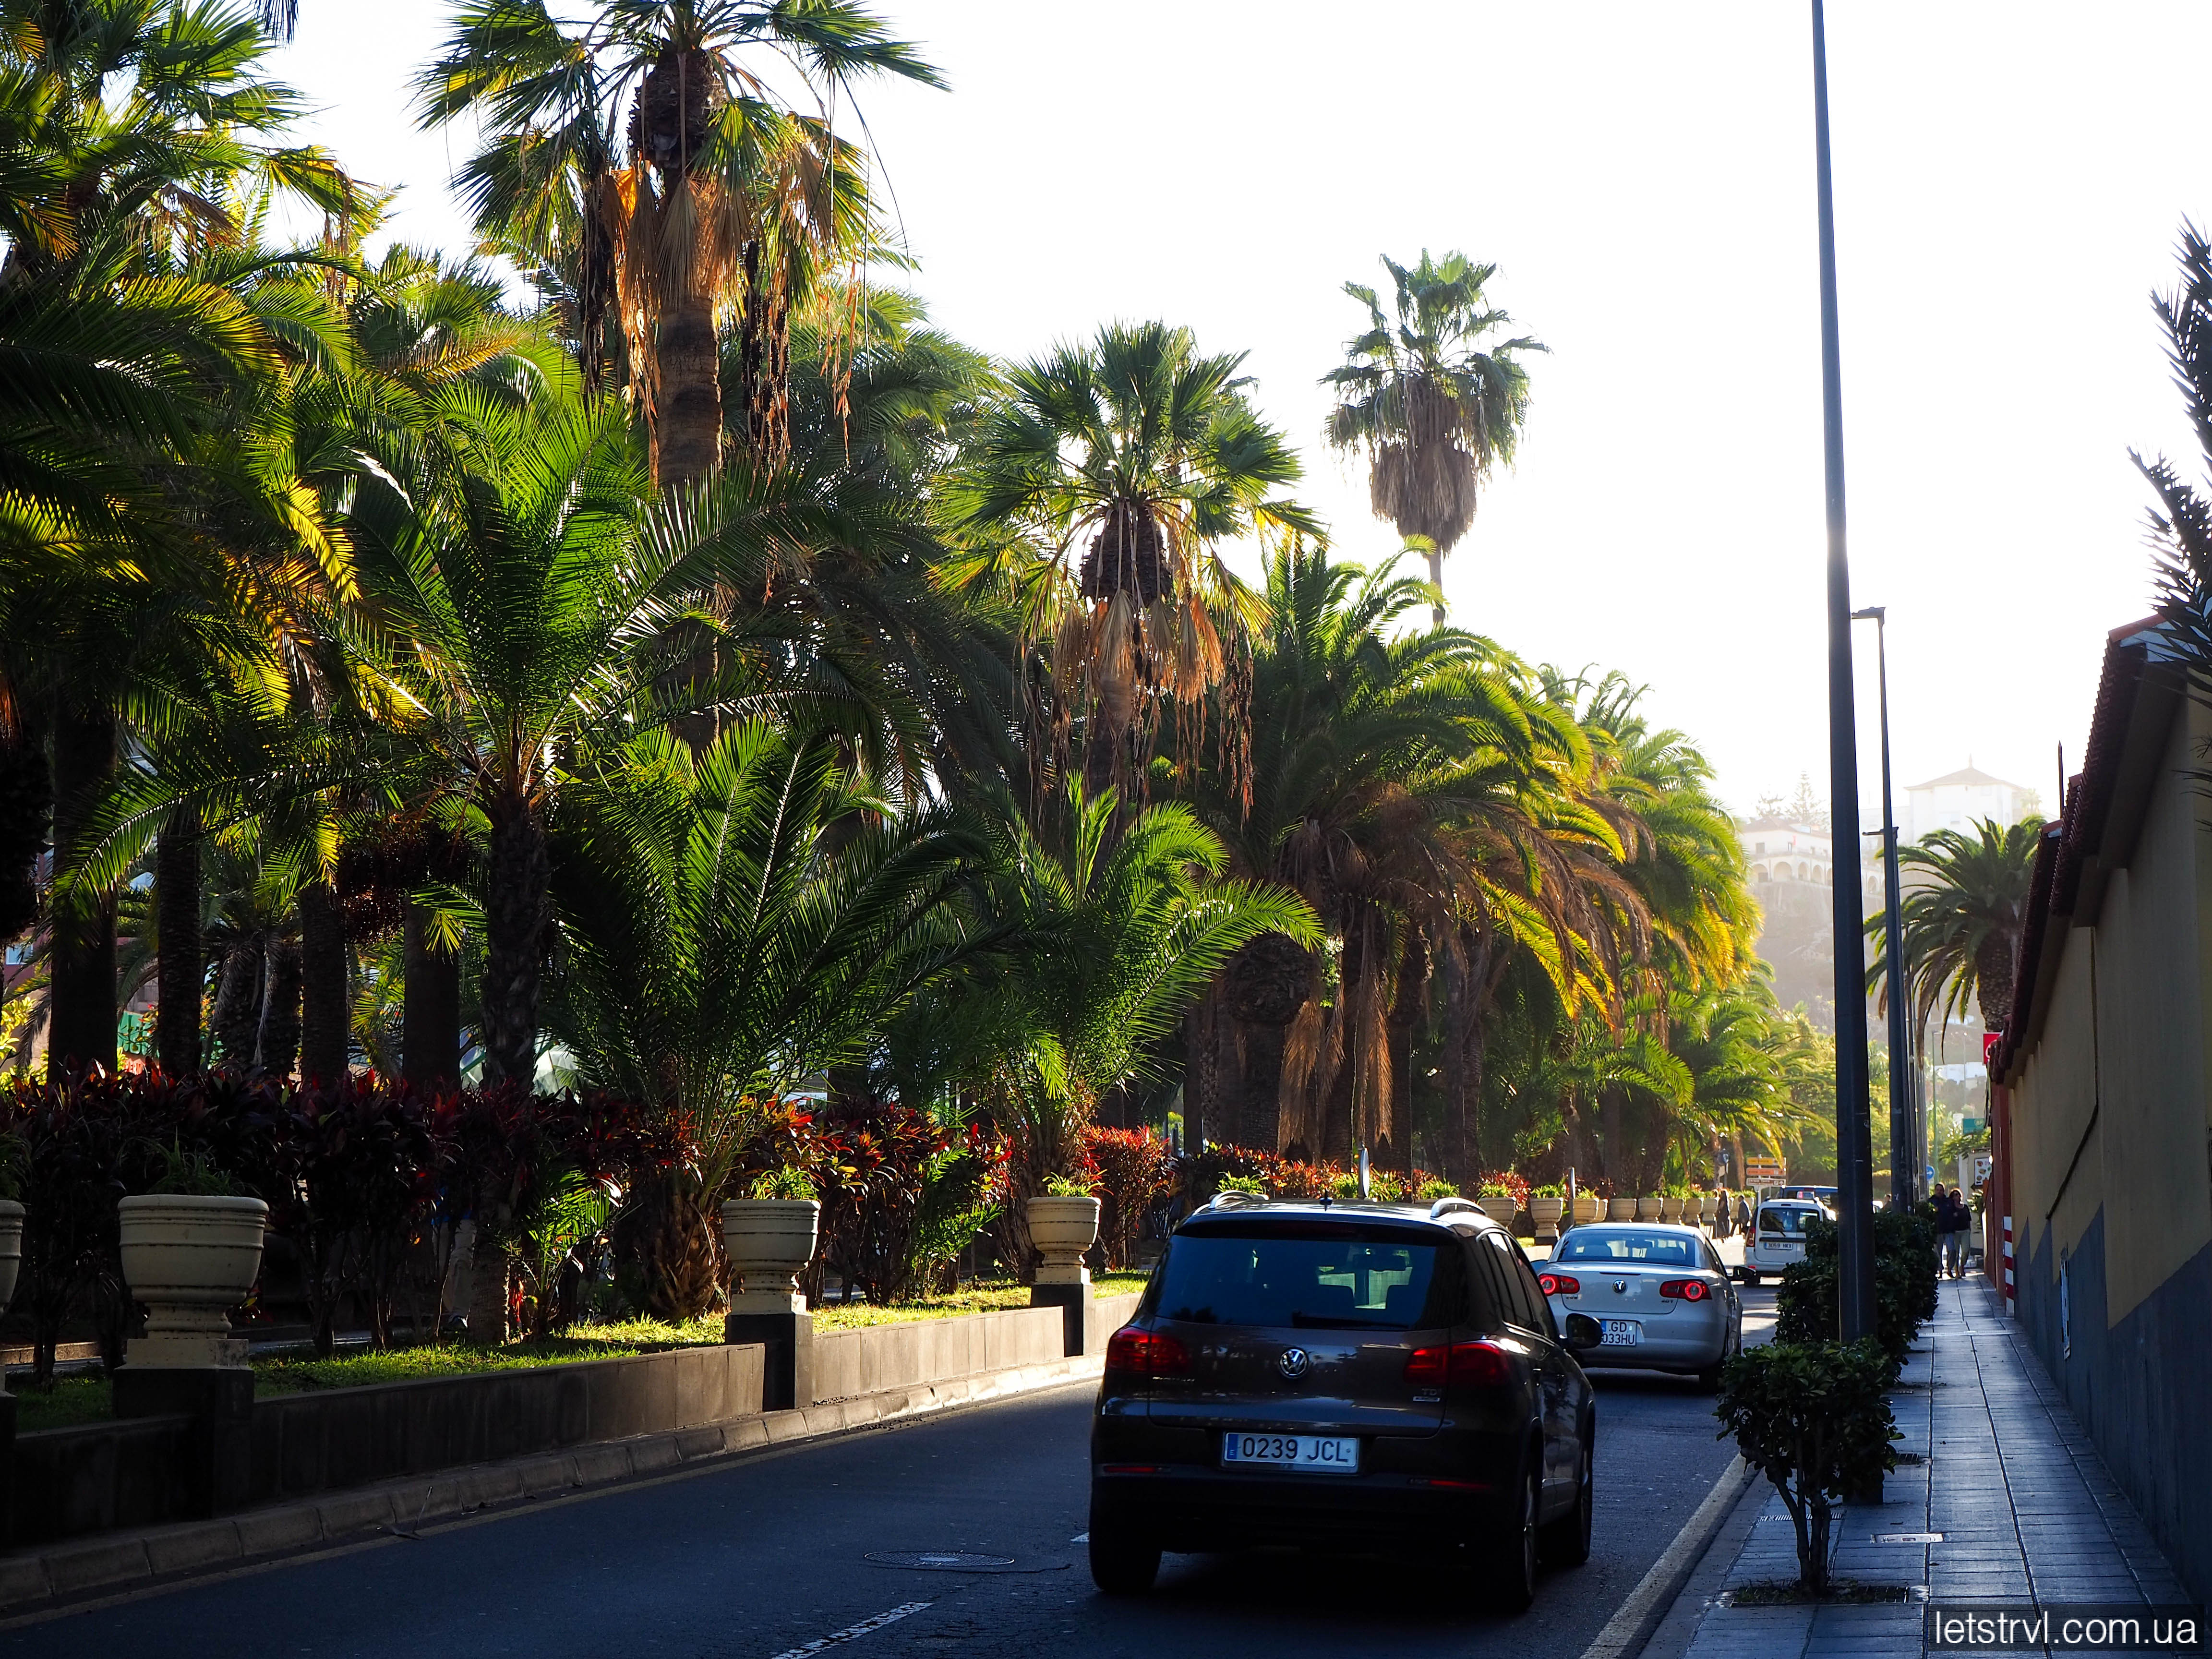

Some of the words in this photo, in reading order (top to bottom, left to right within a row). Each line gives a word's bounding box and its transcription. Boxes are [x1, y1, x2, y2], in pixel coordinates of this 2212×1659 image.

[1611, 1322, 1627, 1332] GD
[1602, 1333, 1635, 1344] 033HU
[1243, 1437, 1298, 1459] 0239
[1307, 1441, 1348, 1462] JCL
